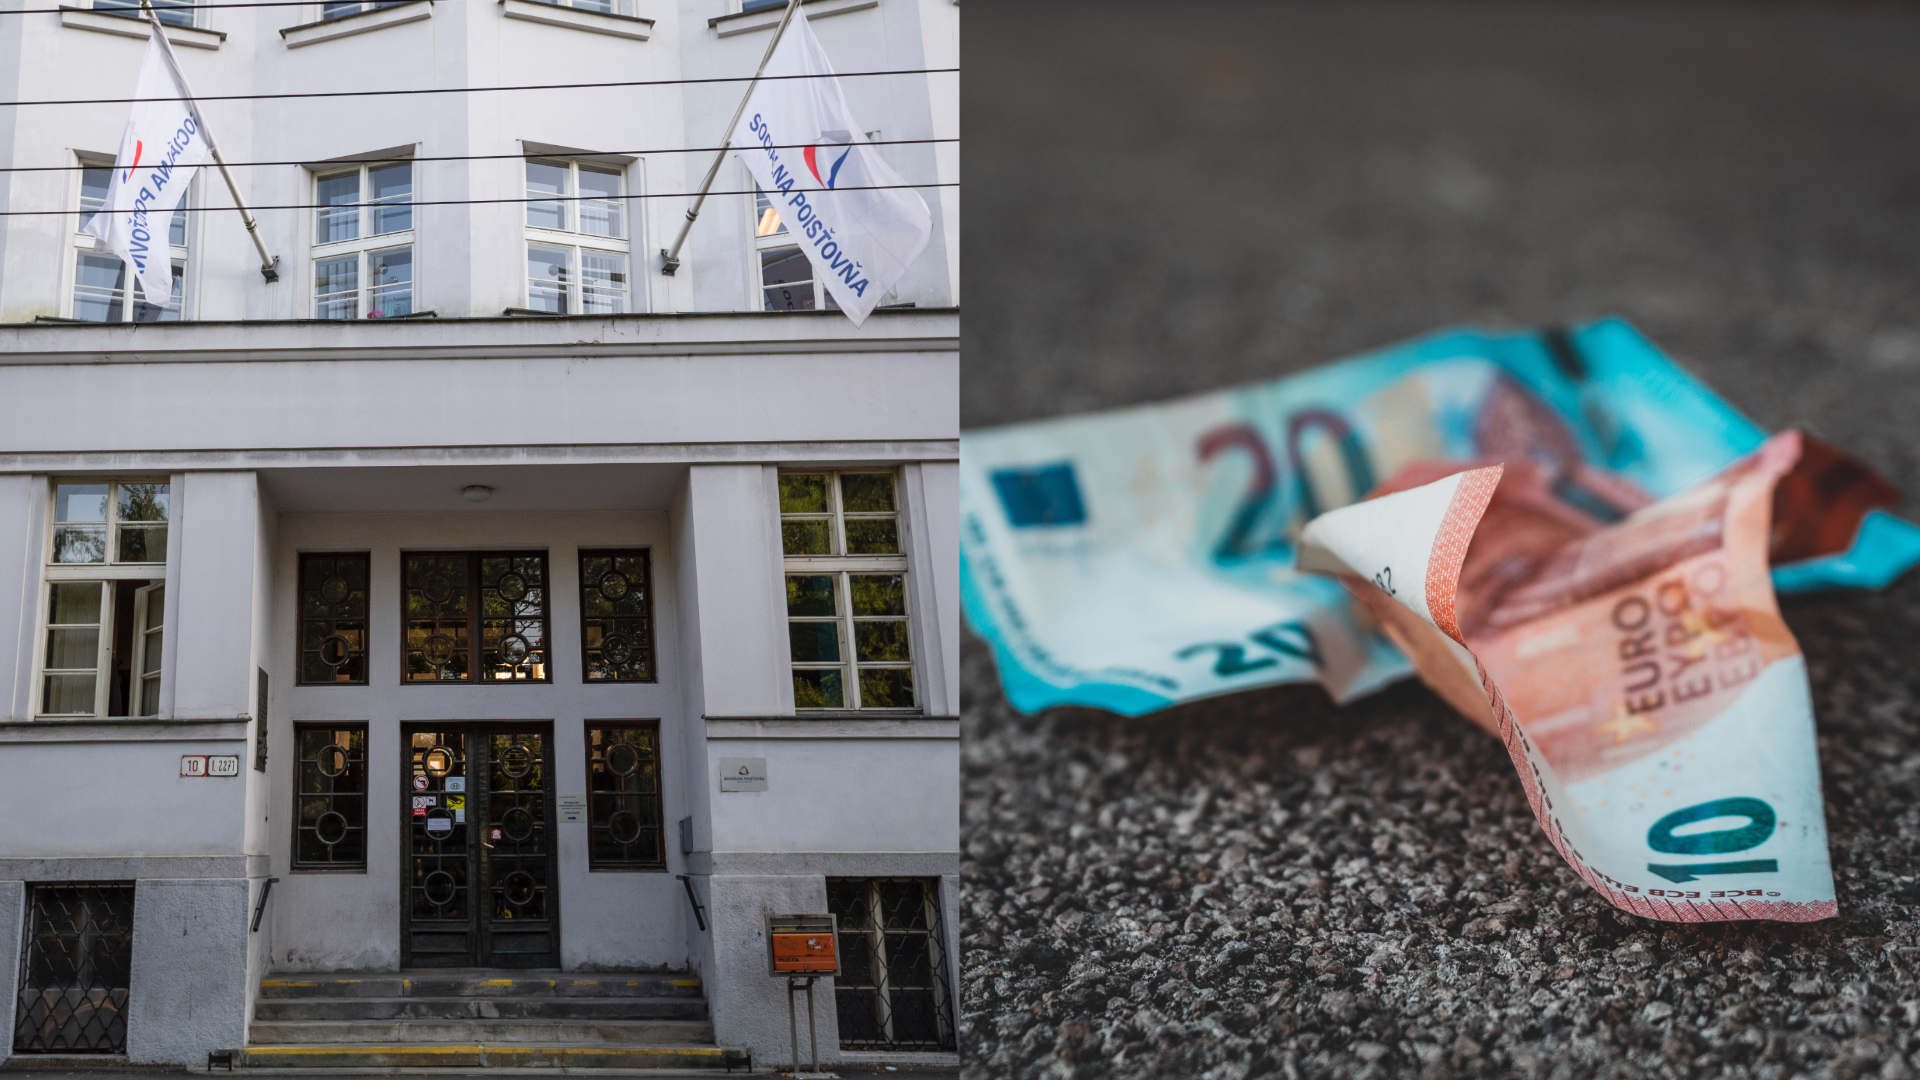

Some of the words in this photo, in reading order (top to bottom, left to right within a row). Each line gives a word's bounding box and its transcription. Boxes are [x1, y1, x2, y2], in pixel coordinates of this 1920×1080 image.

[788, 192, 869, 298] POISŤOVŇA
[1612, 596, 1666, 716] EURO
[187, 760, 199, 772] 10
[1647, 796, 1779, 884] 10
[1648, 888, 1701, 899] ECB
